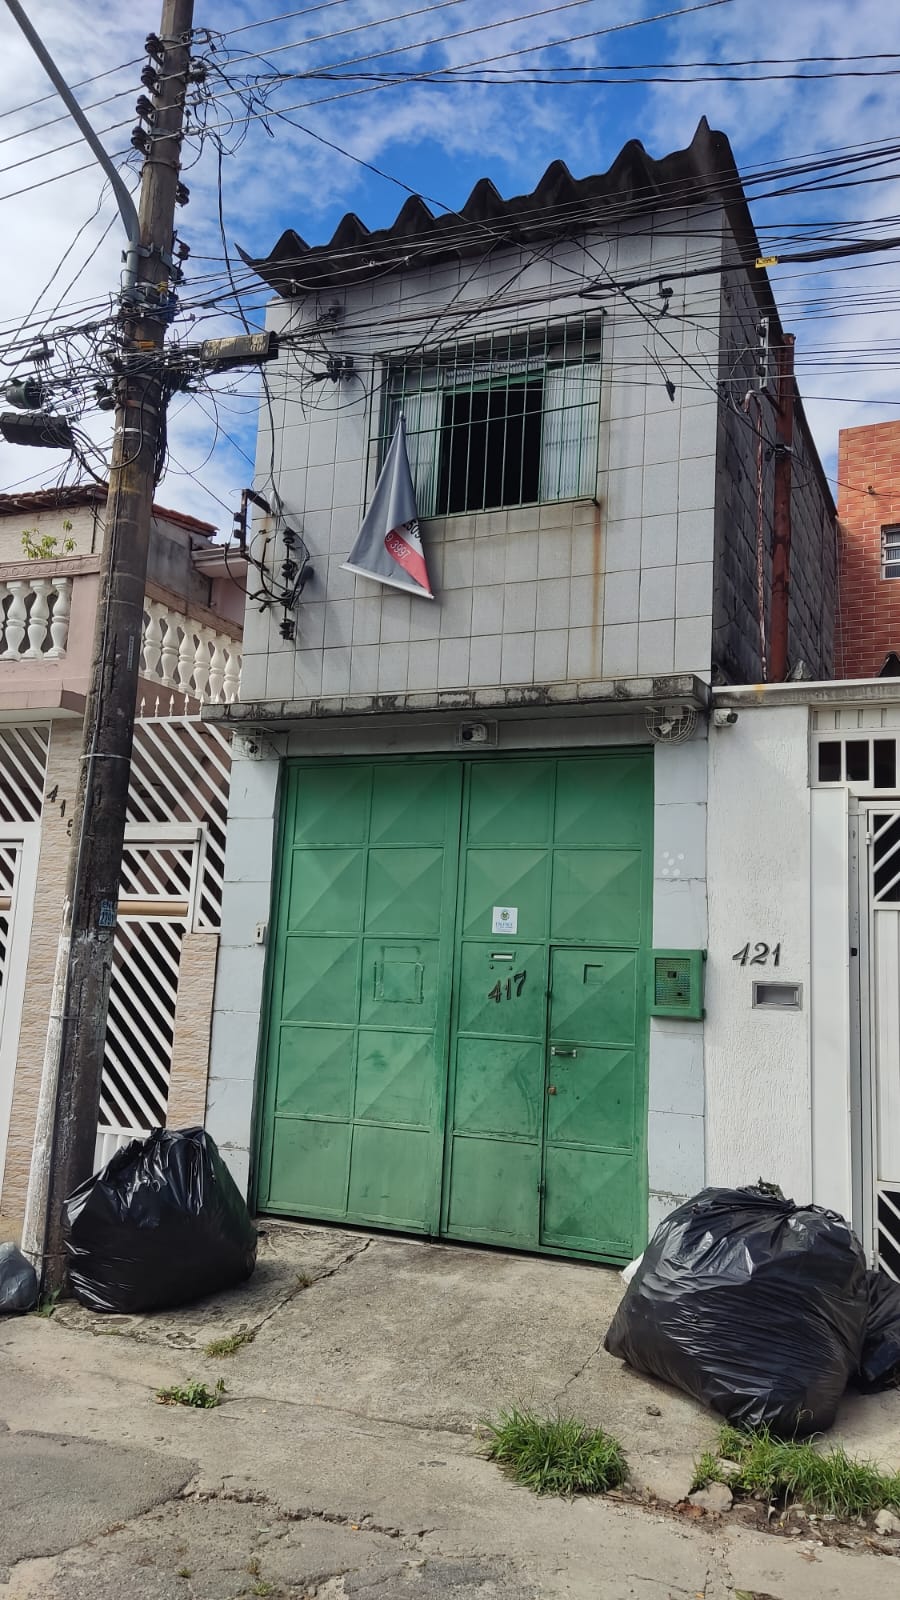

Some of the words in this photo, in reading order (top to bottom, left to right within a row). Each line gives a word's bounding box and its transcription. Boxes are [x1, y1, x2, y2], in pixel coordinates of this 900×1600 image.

[390, 540, 411, 560] 3997
[732, 942, 781, 967] 421
[488, 970, 527, 1003] 417
